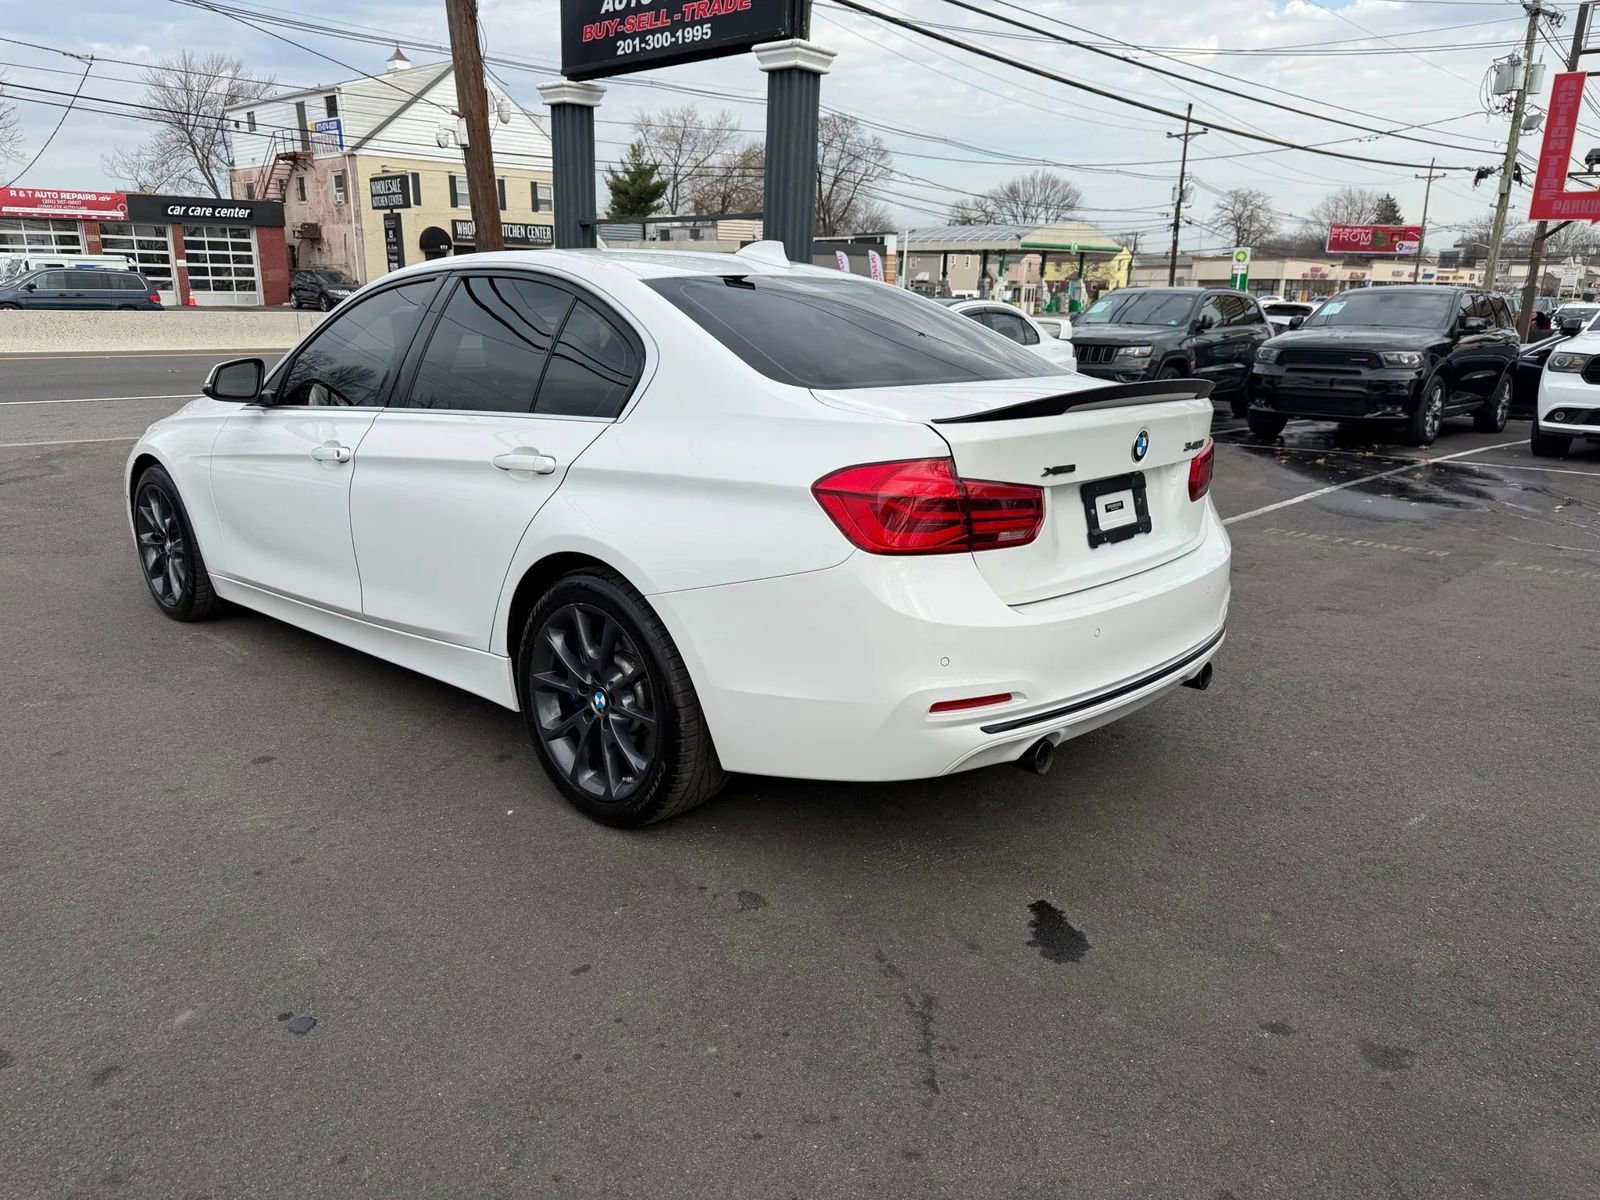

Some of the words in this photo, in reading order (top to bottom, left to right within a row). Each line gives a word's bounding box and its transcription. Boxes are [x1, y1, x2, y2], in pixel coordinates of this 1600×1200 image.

[600, 0, 650, 14] AU
[582, 9, 671, 42] BUY-SELL
[682, 0, 752, 22] TRADE
[616, 23, 712, 56] 201-300-1995
[1548, 79, 1577, 150] ACTION
[1538, 155, 1564, 200] TIRE
[370, 178, 402, 195] WHOLESALE
[18, 190, 26, 198] &
[34, 191, 59, 199] AUTO
[60, 193, 97, 202] REPAIRS
[372, 195, 388, 208] KITCHEN
[388, 194, 404, 206] CENTER
[167, 205, 186, 215] car
[188, 206, 212, 216] care
[214, 207, 251, 218] center
[501, 224, 526, 238] ITCHEN
[526, 225, 552, 239] CENTER
[1330, 231, 1372, 242] FROM
